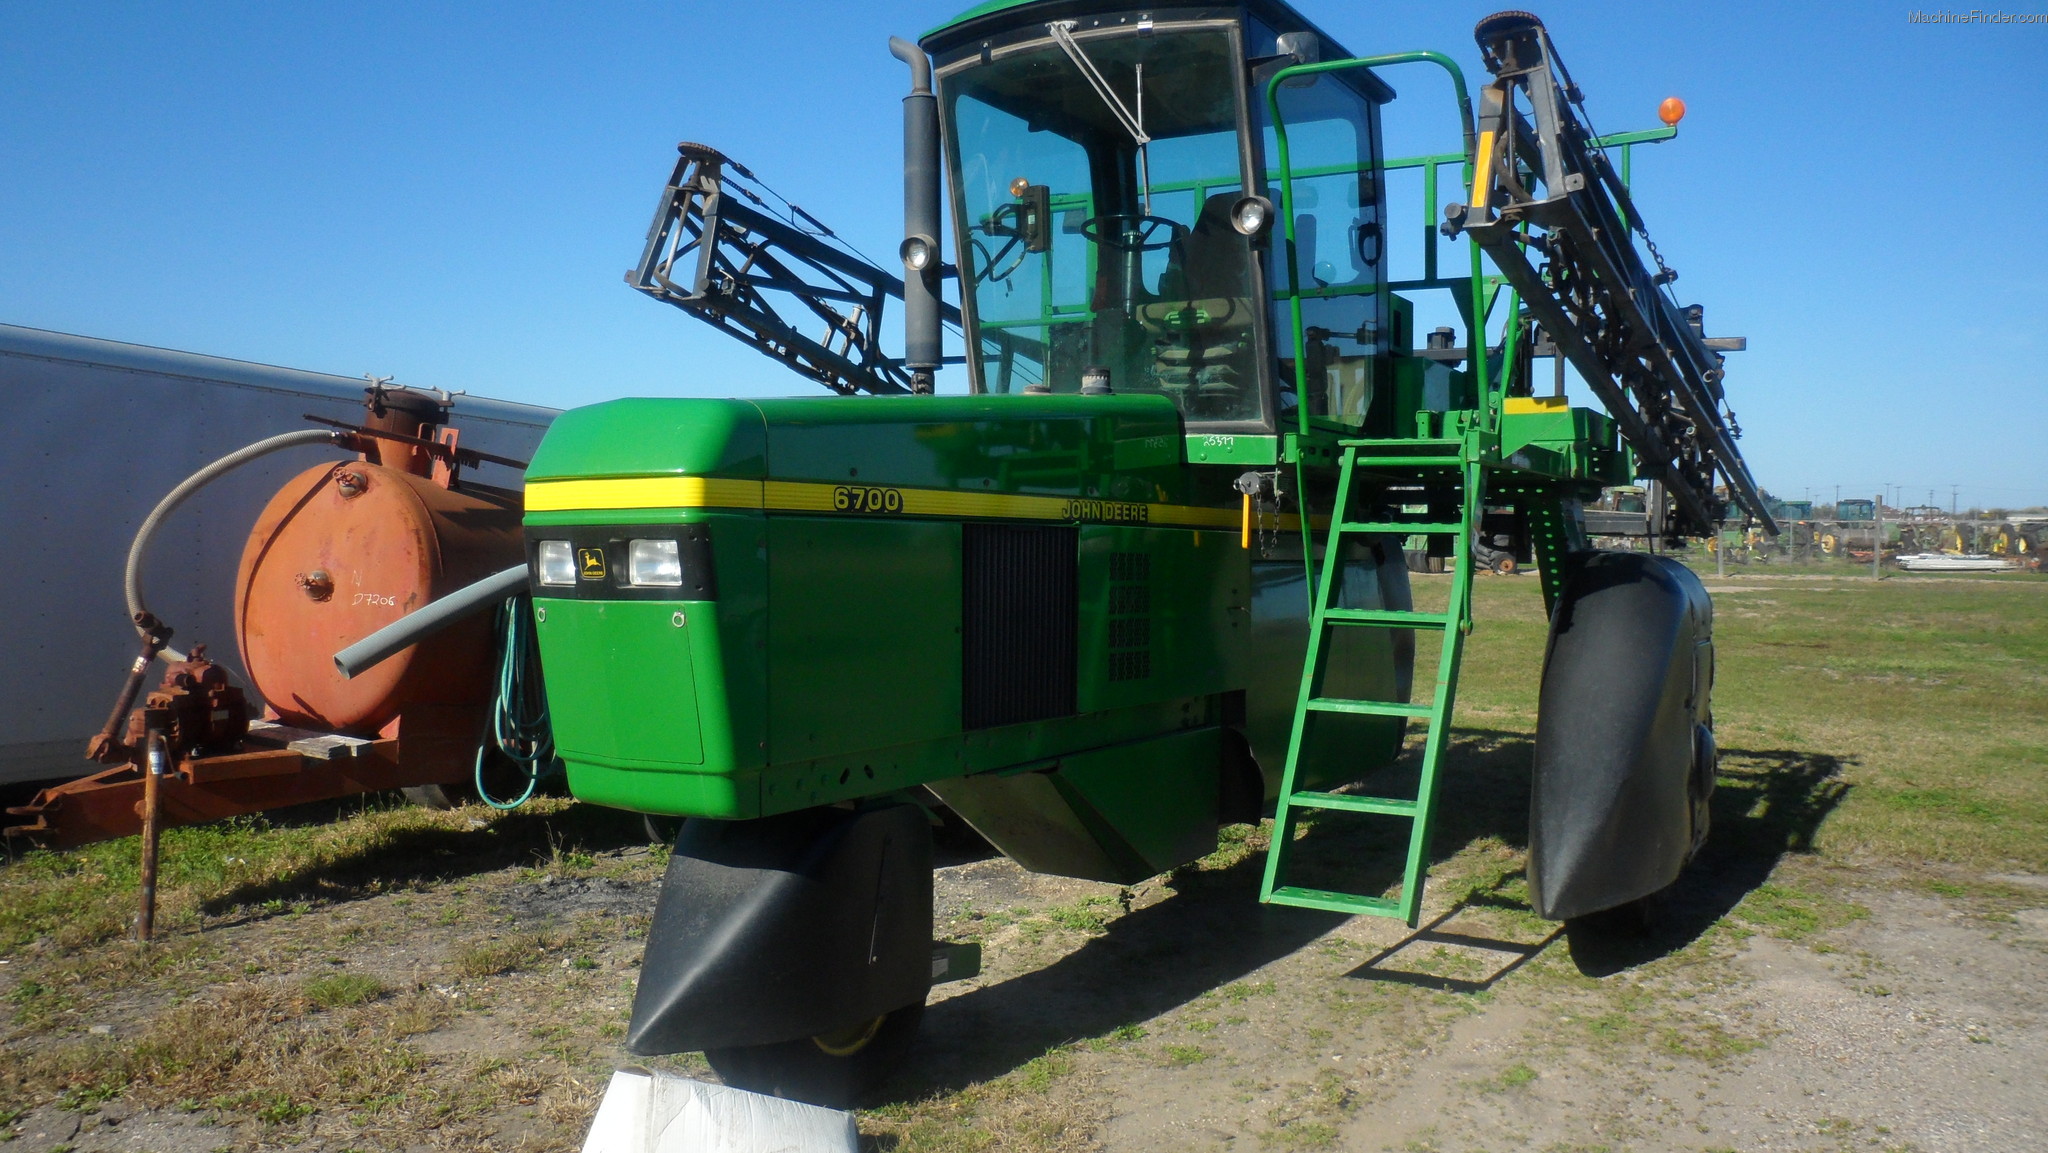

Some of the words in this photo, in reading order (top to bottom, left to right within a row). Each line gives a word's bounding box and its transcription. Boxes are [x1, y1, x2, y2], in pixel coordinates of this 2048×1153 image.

[834, 486, 904, 513] 6700
[1062, 500, 1101, 519] JOHN
[1104, 503, 1148, 521] DEERE
[351, 592, 396, 606] D7206
